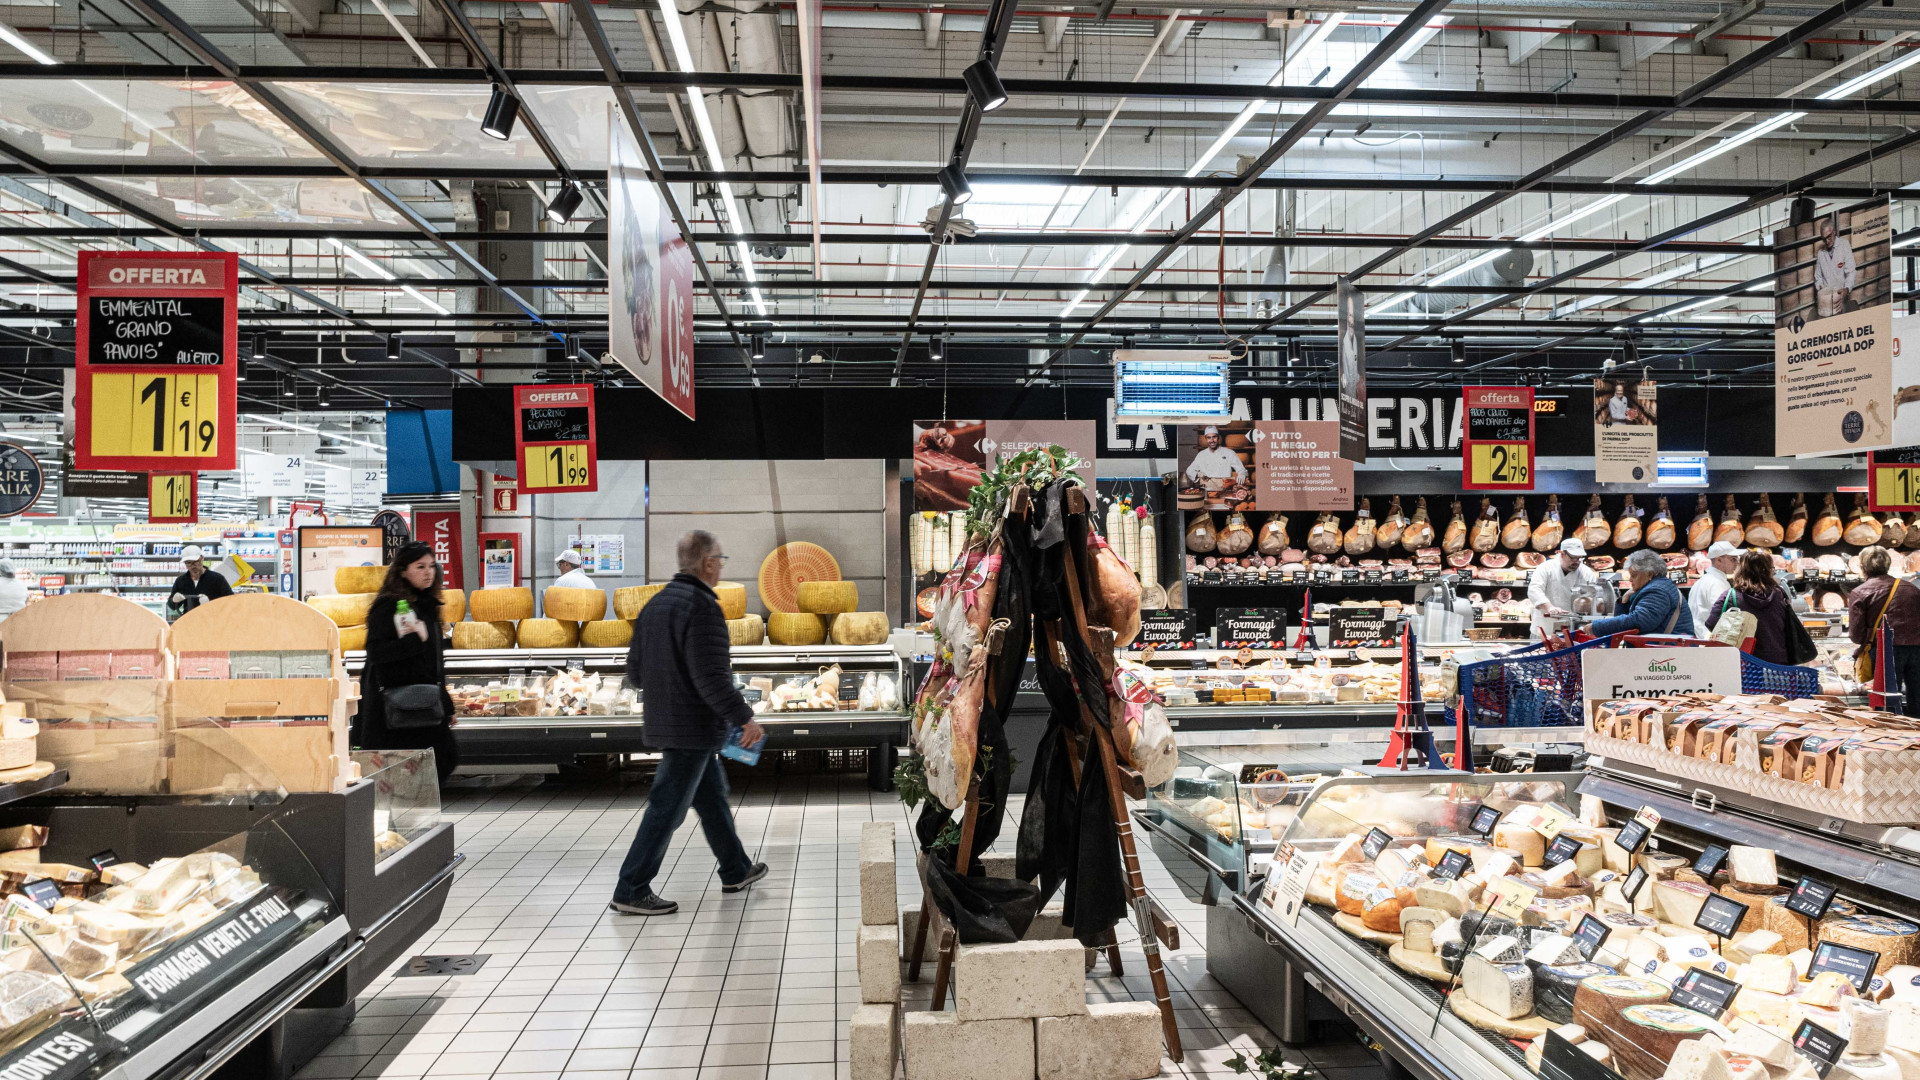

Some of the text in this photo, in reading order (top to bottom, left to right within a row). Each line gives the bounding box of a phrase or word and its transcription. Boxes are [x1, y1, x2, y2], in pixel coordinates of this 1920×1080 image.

[109, 268, 206, 284] OFFERTA
[100, 299, 192, 317] EMMENTAL
[1788, 325, 1874, 351] LA CREMOSITÀ DEL
[1788, 344, 1850, 365] GORGONZOLA
[1854, 339, 1875, 352] DOP
[1798, 382, 1825, 390] bergamasca
[1853, 373, 1872, 382] speciale
[1805, 372, 1829, 381] gorgonzola
[529, 392, 579, 402] OFFERTA
[1480, 392, 1520, 403] offerta
[141, 377, 214, 452] 1 € 19
[530, 408, 566, 419] PECORINO
[527, 420, 562, 431] ROMANO
[1471, 418, 1484, 426] SAN
[1486, 418, 1512, 426] DANIELE
[1001, 442, 1051, 450] SELEZIONE
[1271, 451, 1340, 459] PRONTO PER T
[287, 457, 300, 468] 24
[550, 447, 563, 484] 1
[568, 468, 587, 484] 99
[1491, 446, 1508, 482] 2
[1511, 466, 1528, 482] 79
[365, 472, 377, 481] 22
[1140, 620, 1186, 632] Formaggi
[1228, 619, 1276, 631] Formaggi
[1340, 619, 1386, 630] Formaggi
[1144, 631, 1181, 642] Europei
[1233, 630, 1271, 641] Europei
[1345, 629, 1381, 640] Europei
[1648, 662, 1677, 674] disalp
[134, 894, 290, 1000] FORMAGGI VENETI E FRIULI
